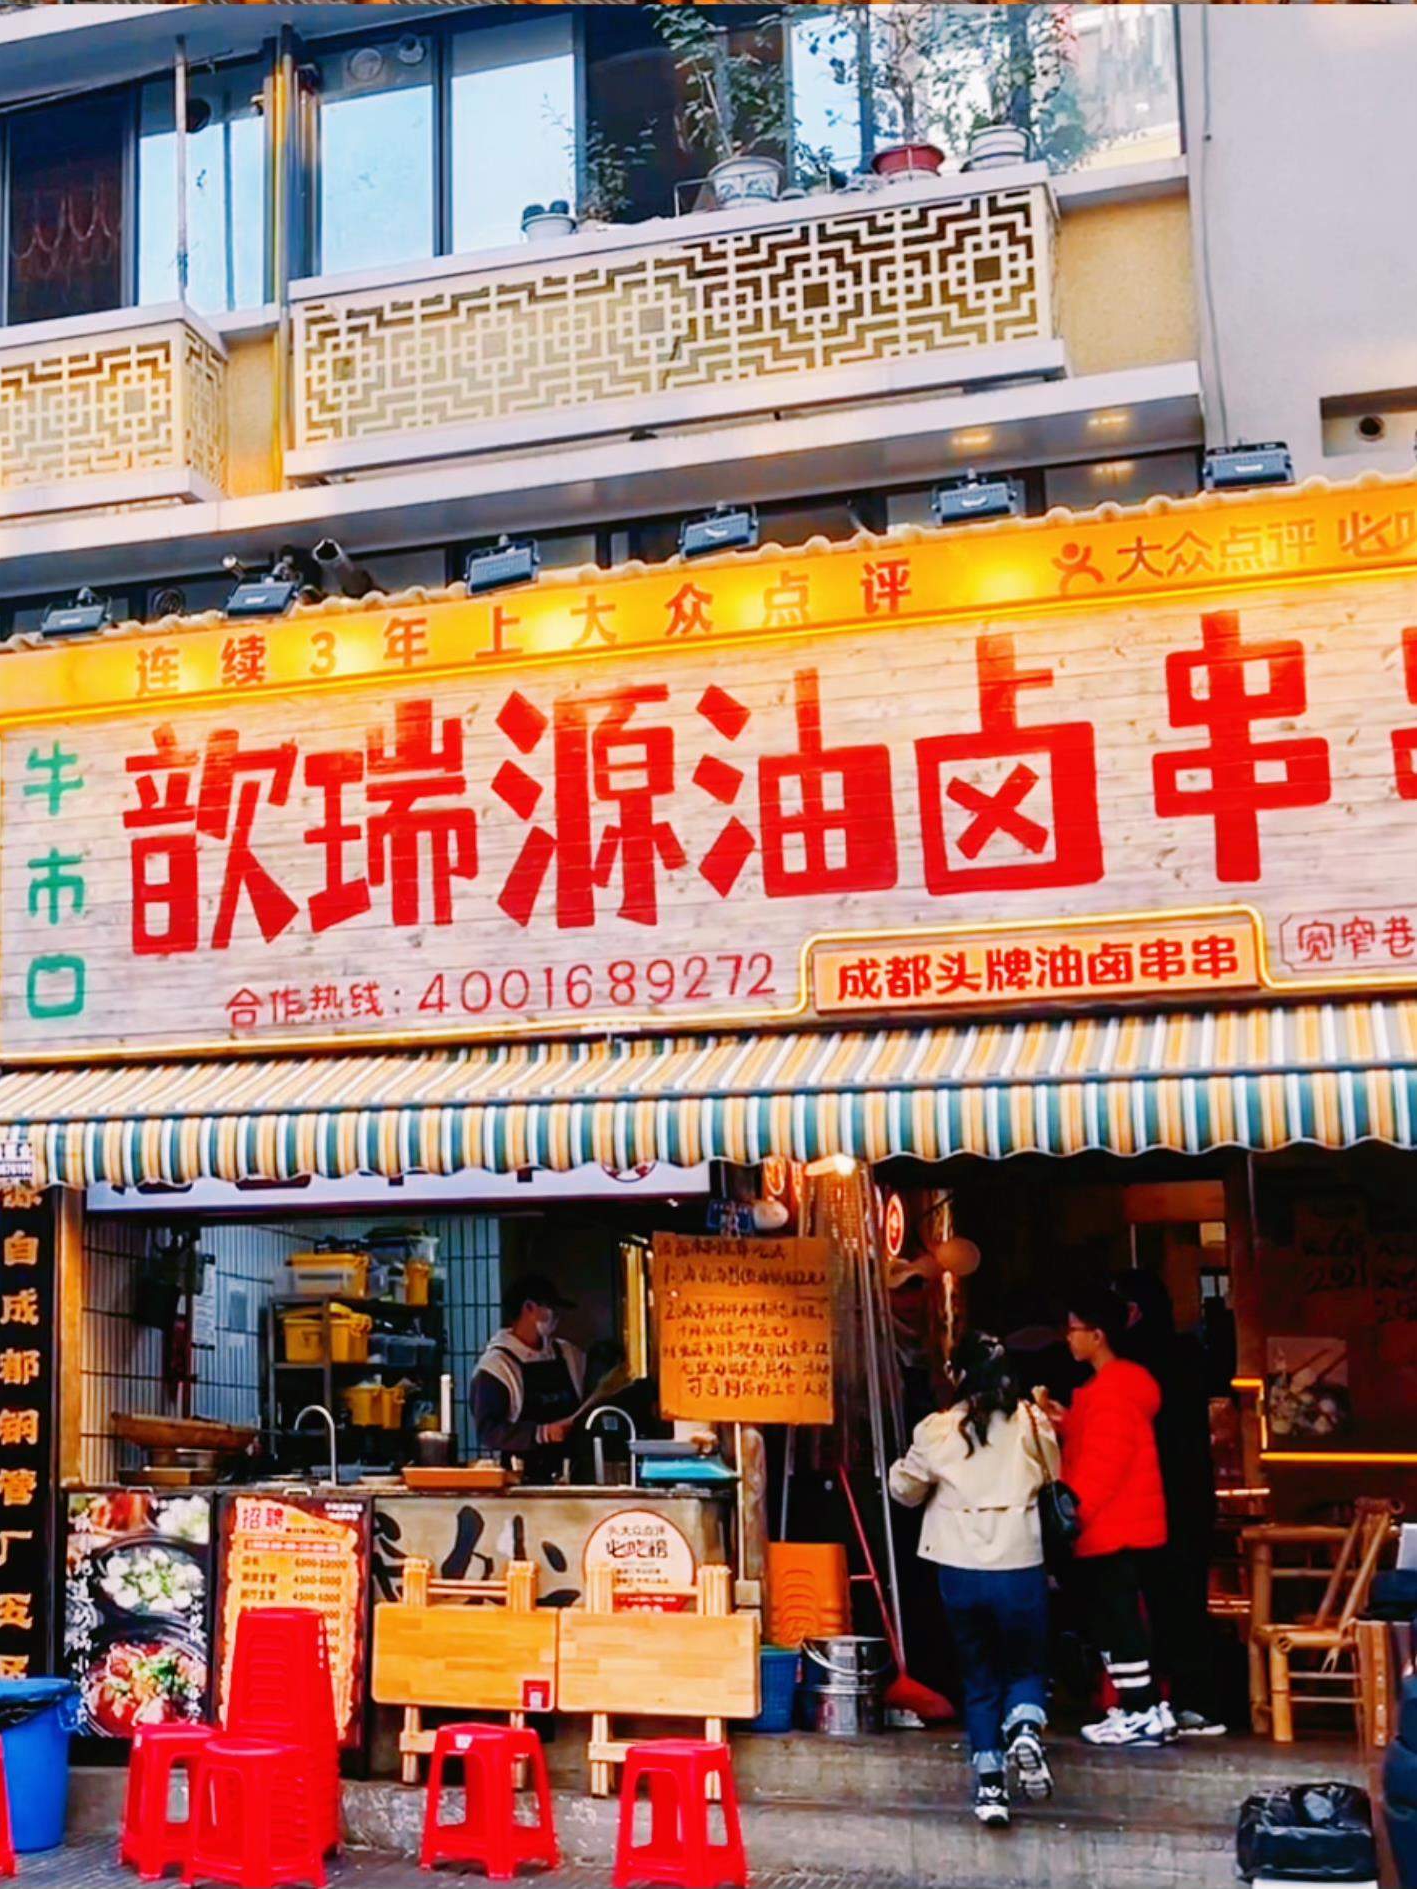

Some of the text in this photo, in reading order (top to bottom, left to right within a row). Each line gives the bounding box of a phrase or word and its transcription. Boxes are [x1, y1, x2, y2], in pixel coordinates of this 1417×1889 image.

[1116, 521, 1317, 584] 大众点评
[135, 559, 912, 697] 连续3年上大众点评
[123, 610, 1417, 956] 歆瑞源油卤串
[23, 739, 86, 1019] 牛市口
[836, 935, 1239, 1003] 成都头牌油卤串串
[1297, 915, 1417, 963] 宽窄巷
[416, 951, 776, 1016] 4001689272
[242, 1507, 284, 1530] 招聘
